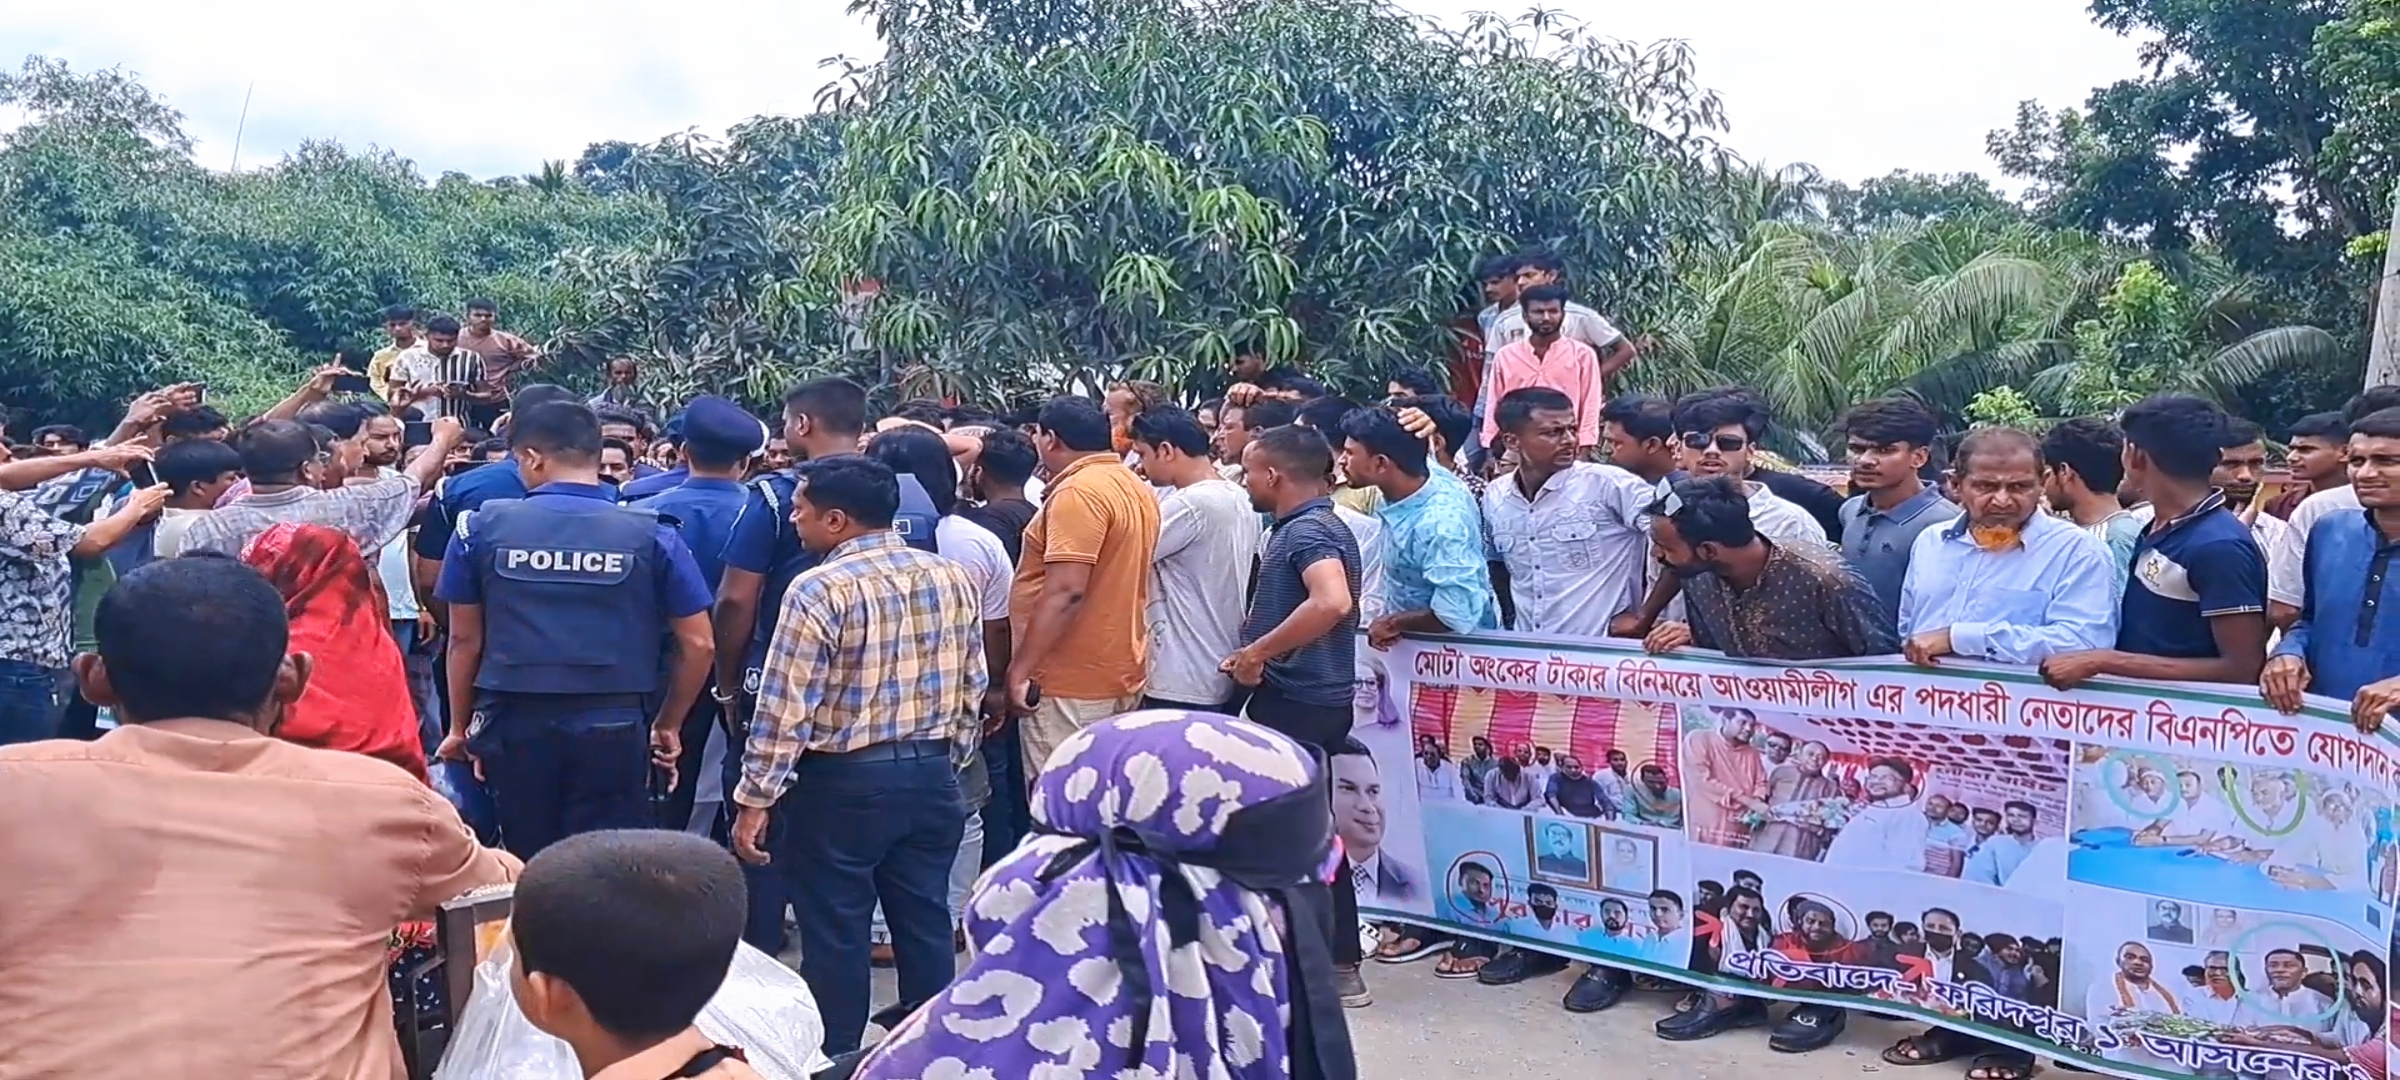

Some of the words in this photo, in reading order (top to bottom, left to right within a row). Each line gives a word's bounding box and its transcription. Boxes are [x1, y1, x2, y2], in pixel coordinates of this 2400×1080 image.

[507, 549, 624, 574] POLICE
[1414, 644, 1464, 679] মোটা
[1469, 655, 1540, 686] অংকের
[1546, 655, 1610, 692] টাকার
[1617, 659, 1701, 698] বিনিময়ে
[1708, 668, 1857, 710] আওয়ামীলীগ
[1866, 682, 1906, 714] এর
[1915, 681, 2011, 726] পদধারী
[2020, 697, 2138, 740] নেতাদের
[2145, 699, 2300, 756] বিএনপিতে
[1925, 979, 2087, 1046] ফরিদপুর
[2137, 1028, 2342, 1080] আসনের
